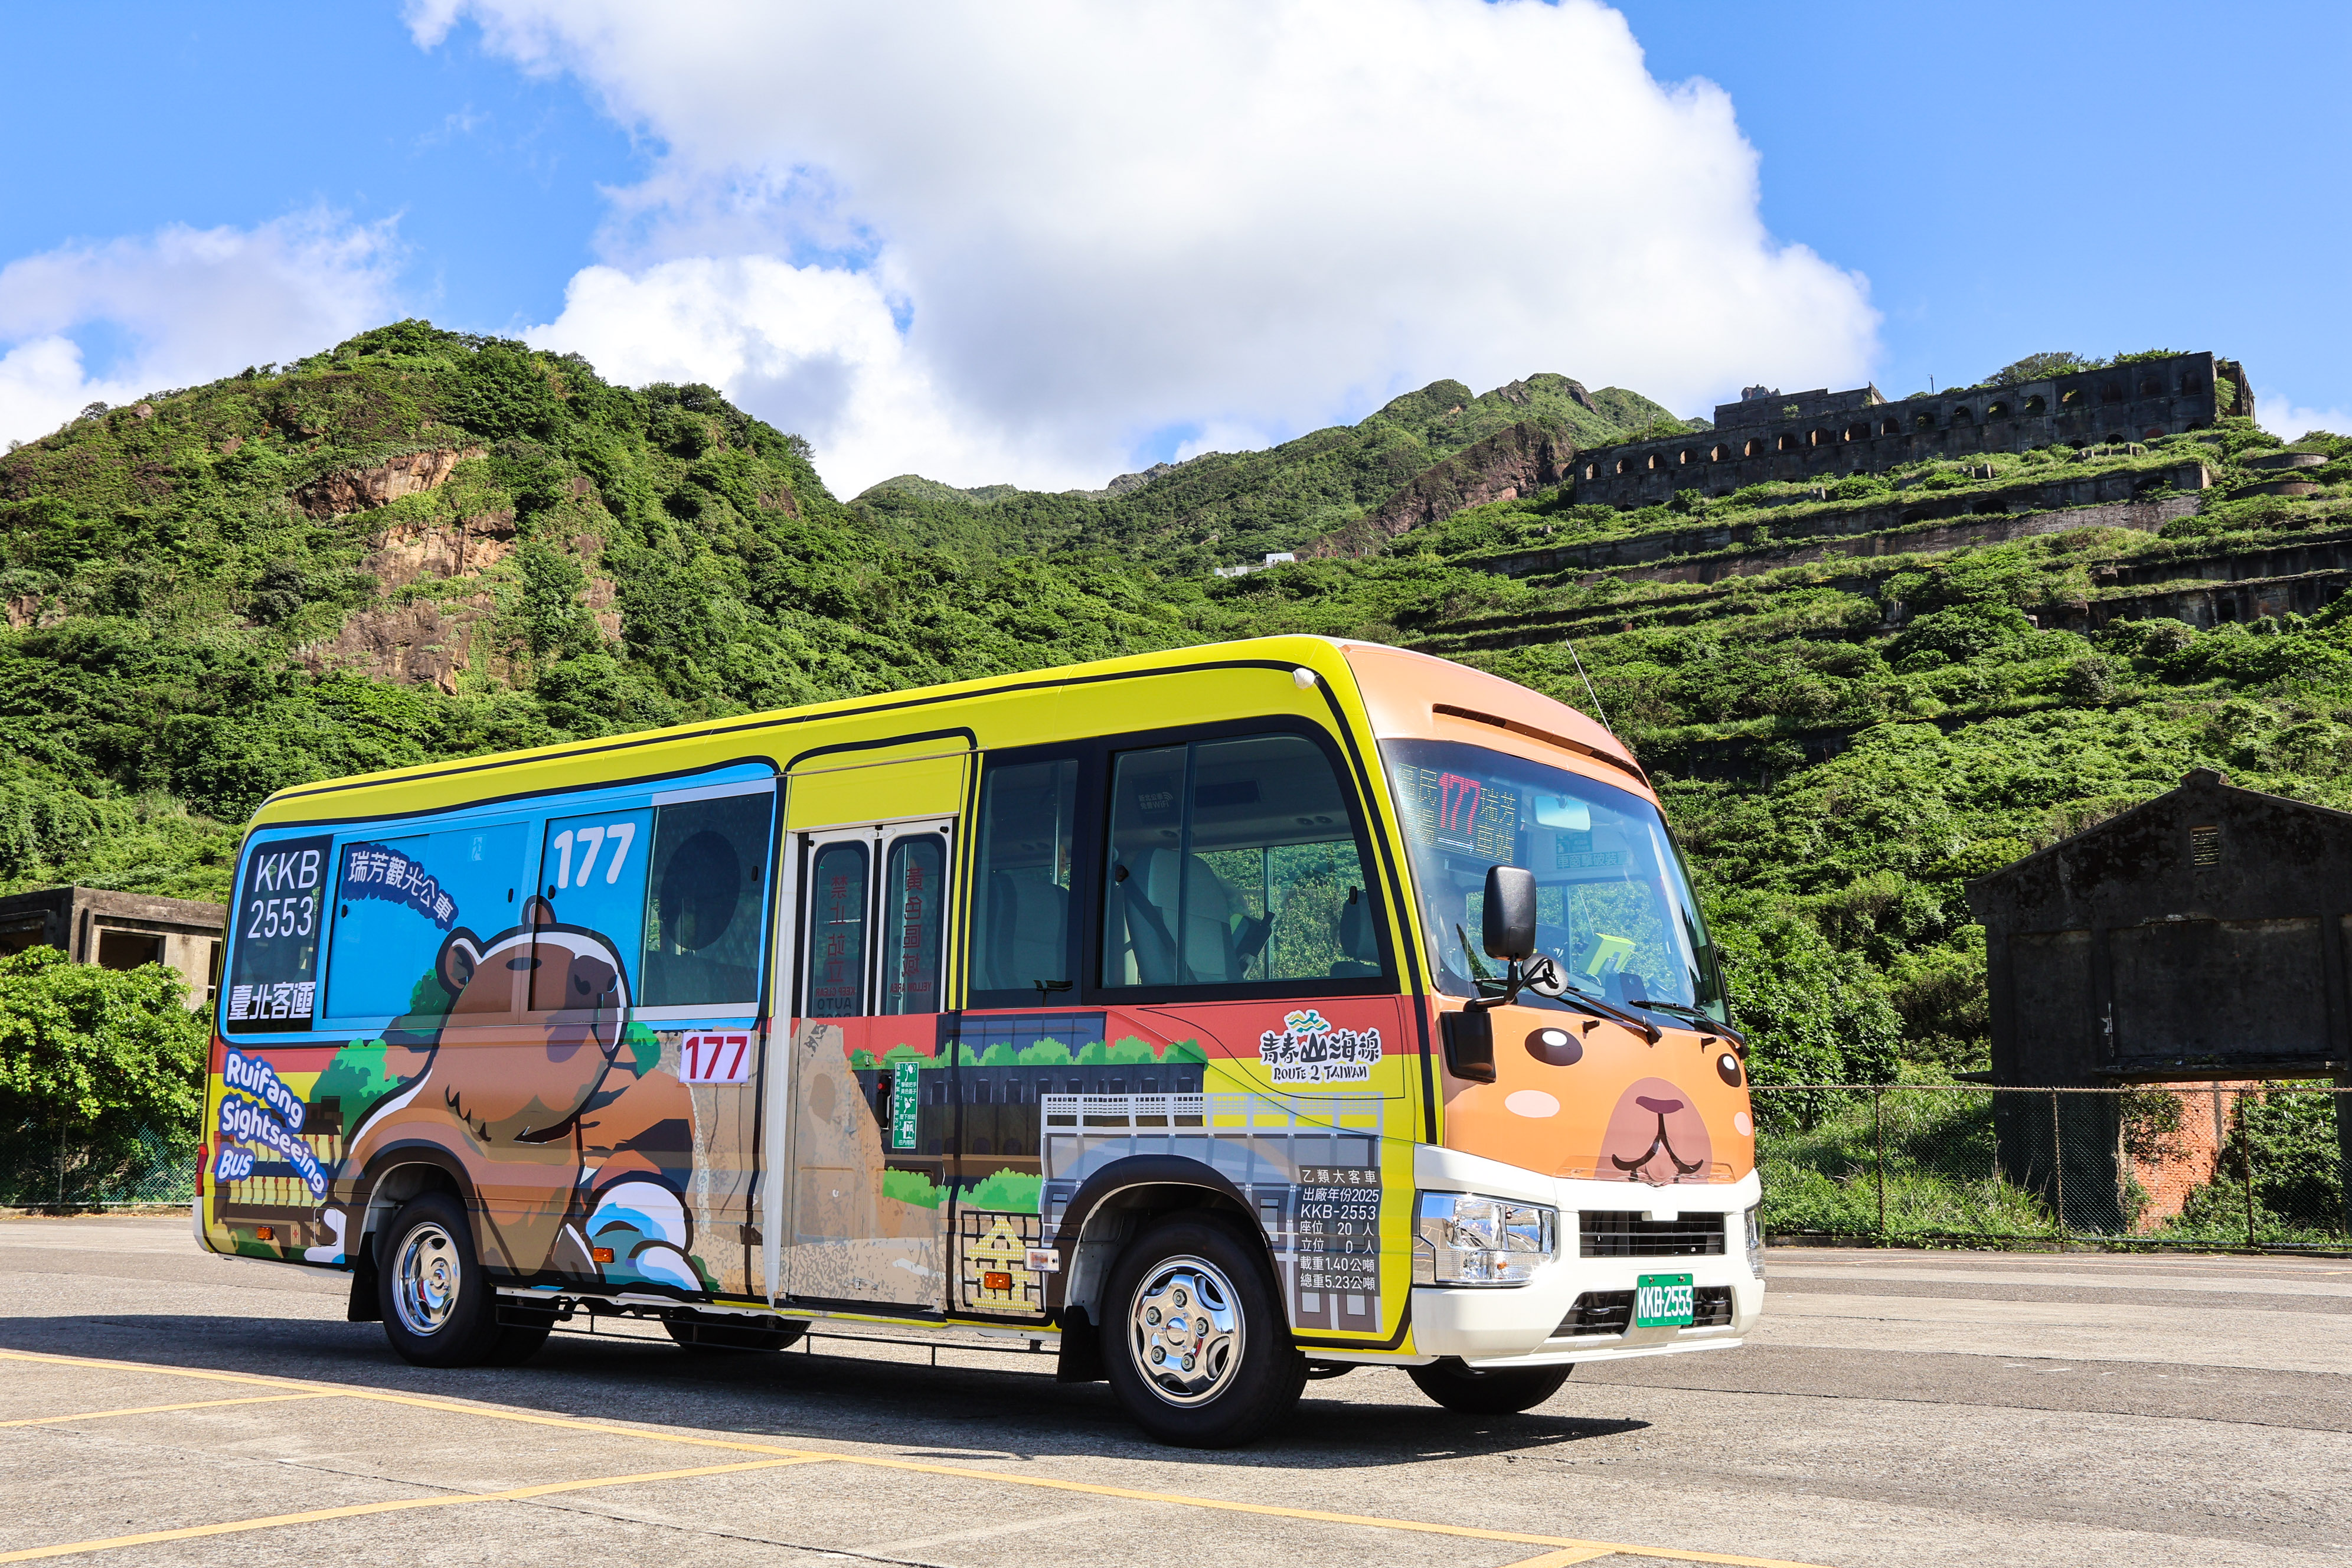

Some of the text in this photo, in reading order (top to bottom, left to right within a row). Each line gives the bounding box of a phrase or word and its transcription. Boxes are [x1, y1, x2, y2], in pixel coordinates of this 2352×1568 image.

[1439, 772, 1481, 835] 177
[1479, 788, 1516, 826] 瑞芳
[554, 822, 636, 889] 177
[1476, 822, 1515, 864] 車站
[254, 850, 320, 892] KKB
[348, 850, 453, 922] 瑞芳觀光公車
[247, 896, 313, 939] 2553
[228, 982, 316, 1020] 臺北客運
[686, 1036, 747, 1079] 177
[1262, 1031, 1379, 1064] 青春山海線
[227, 1054, 303, 1128] Ruifang
[1273, 1065, 1367, 1080] ROUTE 2 TAIWAN
[222, 1100, 325, 1194] Sightseeing
[1302, 1169, 1377, 1184] 乙類大客車
[1303, 1187, 1380, 1203] 出廠年份2025
[1300, 1220, 1374, 1236] 座位 20 人
[1301, 1204, 1376, 1220] KKB-2553
[1300, 1237, 1374, 1255] 立位 0 人
[1300, 1256, 1375, 1273] 載重1.40公噸
[1301, 1273, 1376, 1291] 總重5.23公噸
[1638, 1285, 1693, 1319] KKB-2553
